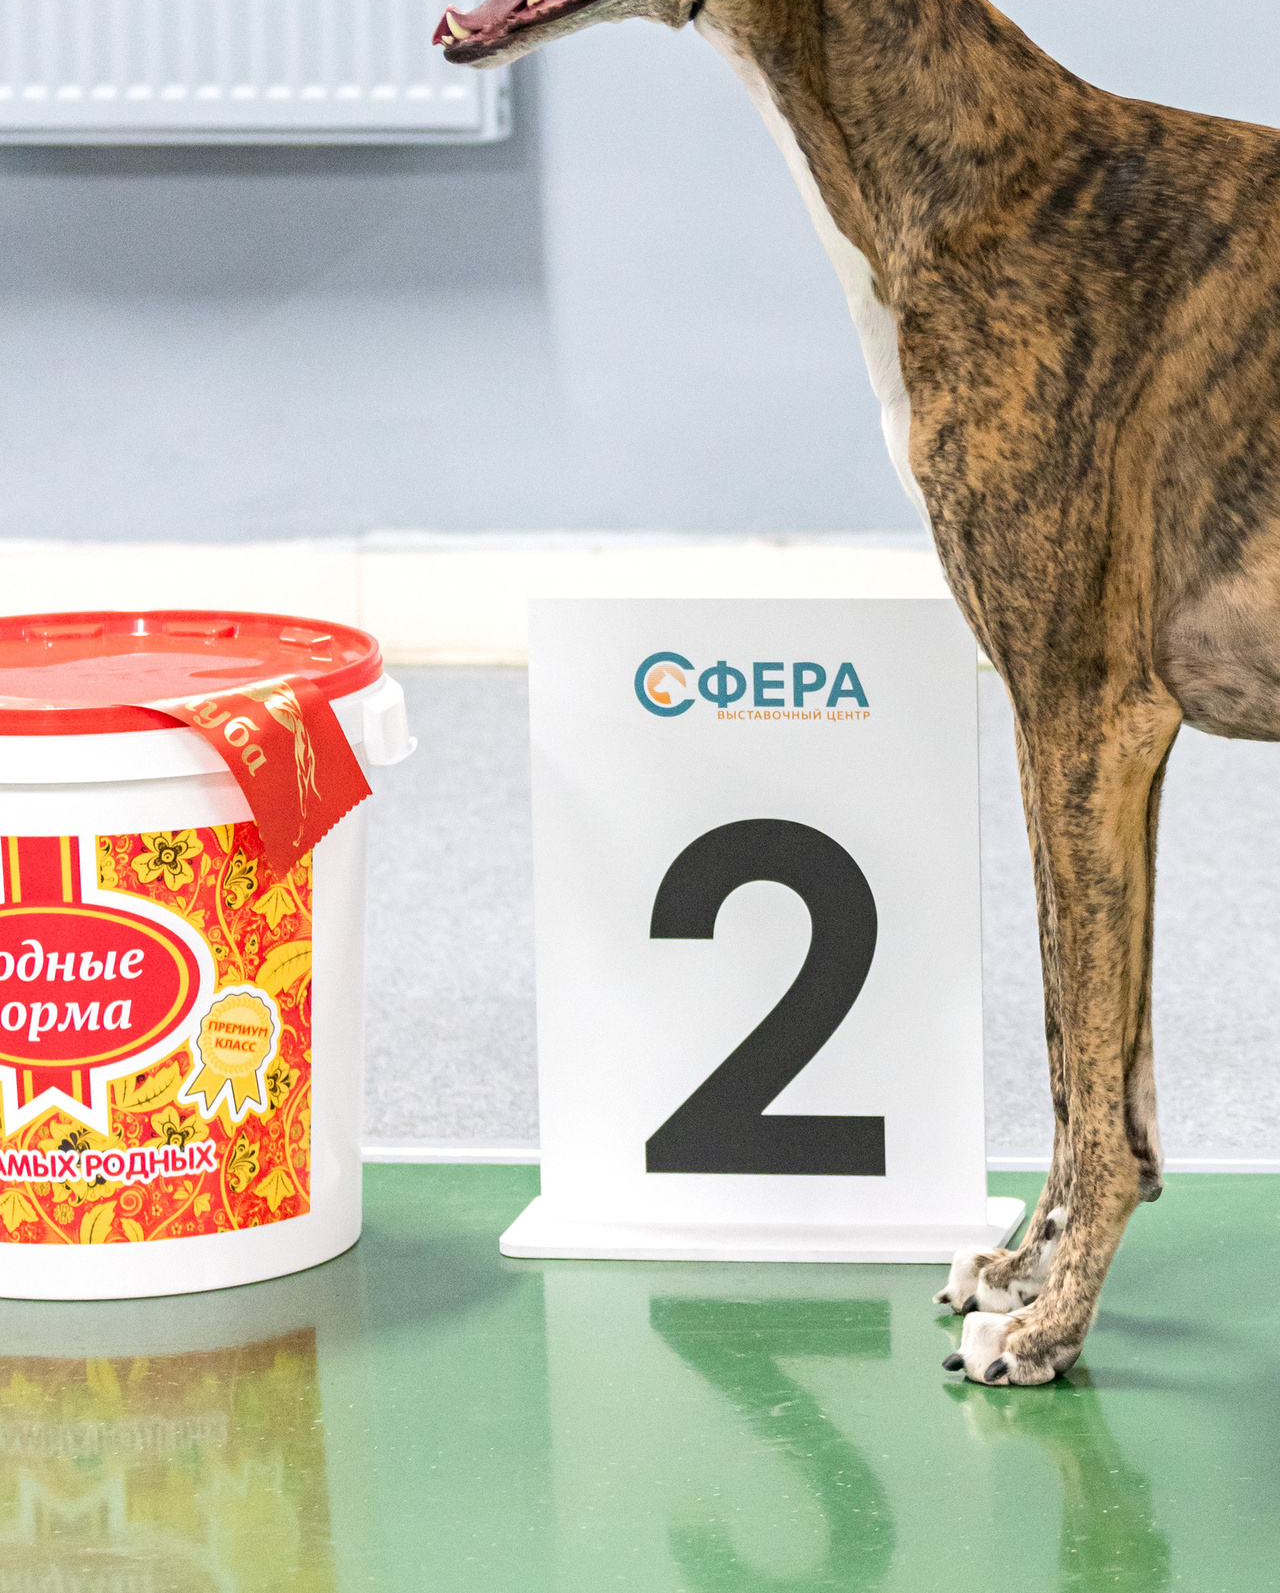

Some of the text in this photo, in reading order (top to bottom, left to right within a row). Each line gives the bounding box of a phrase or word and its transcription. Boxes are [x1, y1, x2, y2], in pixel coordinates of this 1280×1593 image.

[633, 651, 870, 718] СФЕРА
[717, 708, 871, 722] ВЫСТАВОЧНЫЙ ЦЕНТР
[0, 939, 145, 982] одные
[645, 817, 887, 1177] 2
[0, 999, 132, 1042] орма
[208, 1020, 269, 1038] ПРЕМИУМ
[214, 1037, 257, 1053] КЛАСС
[85, 1144, 214, 1181] РОДНЫХ
